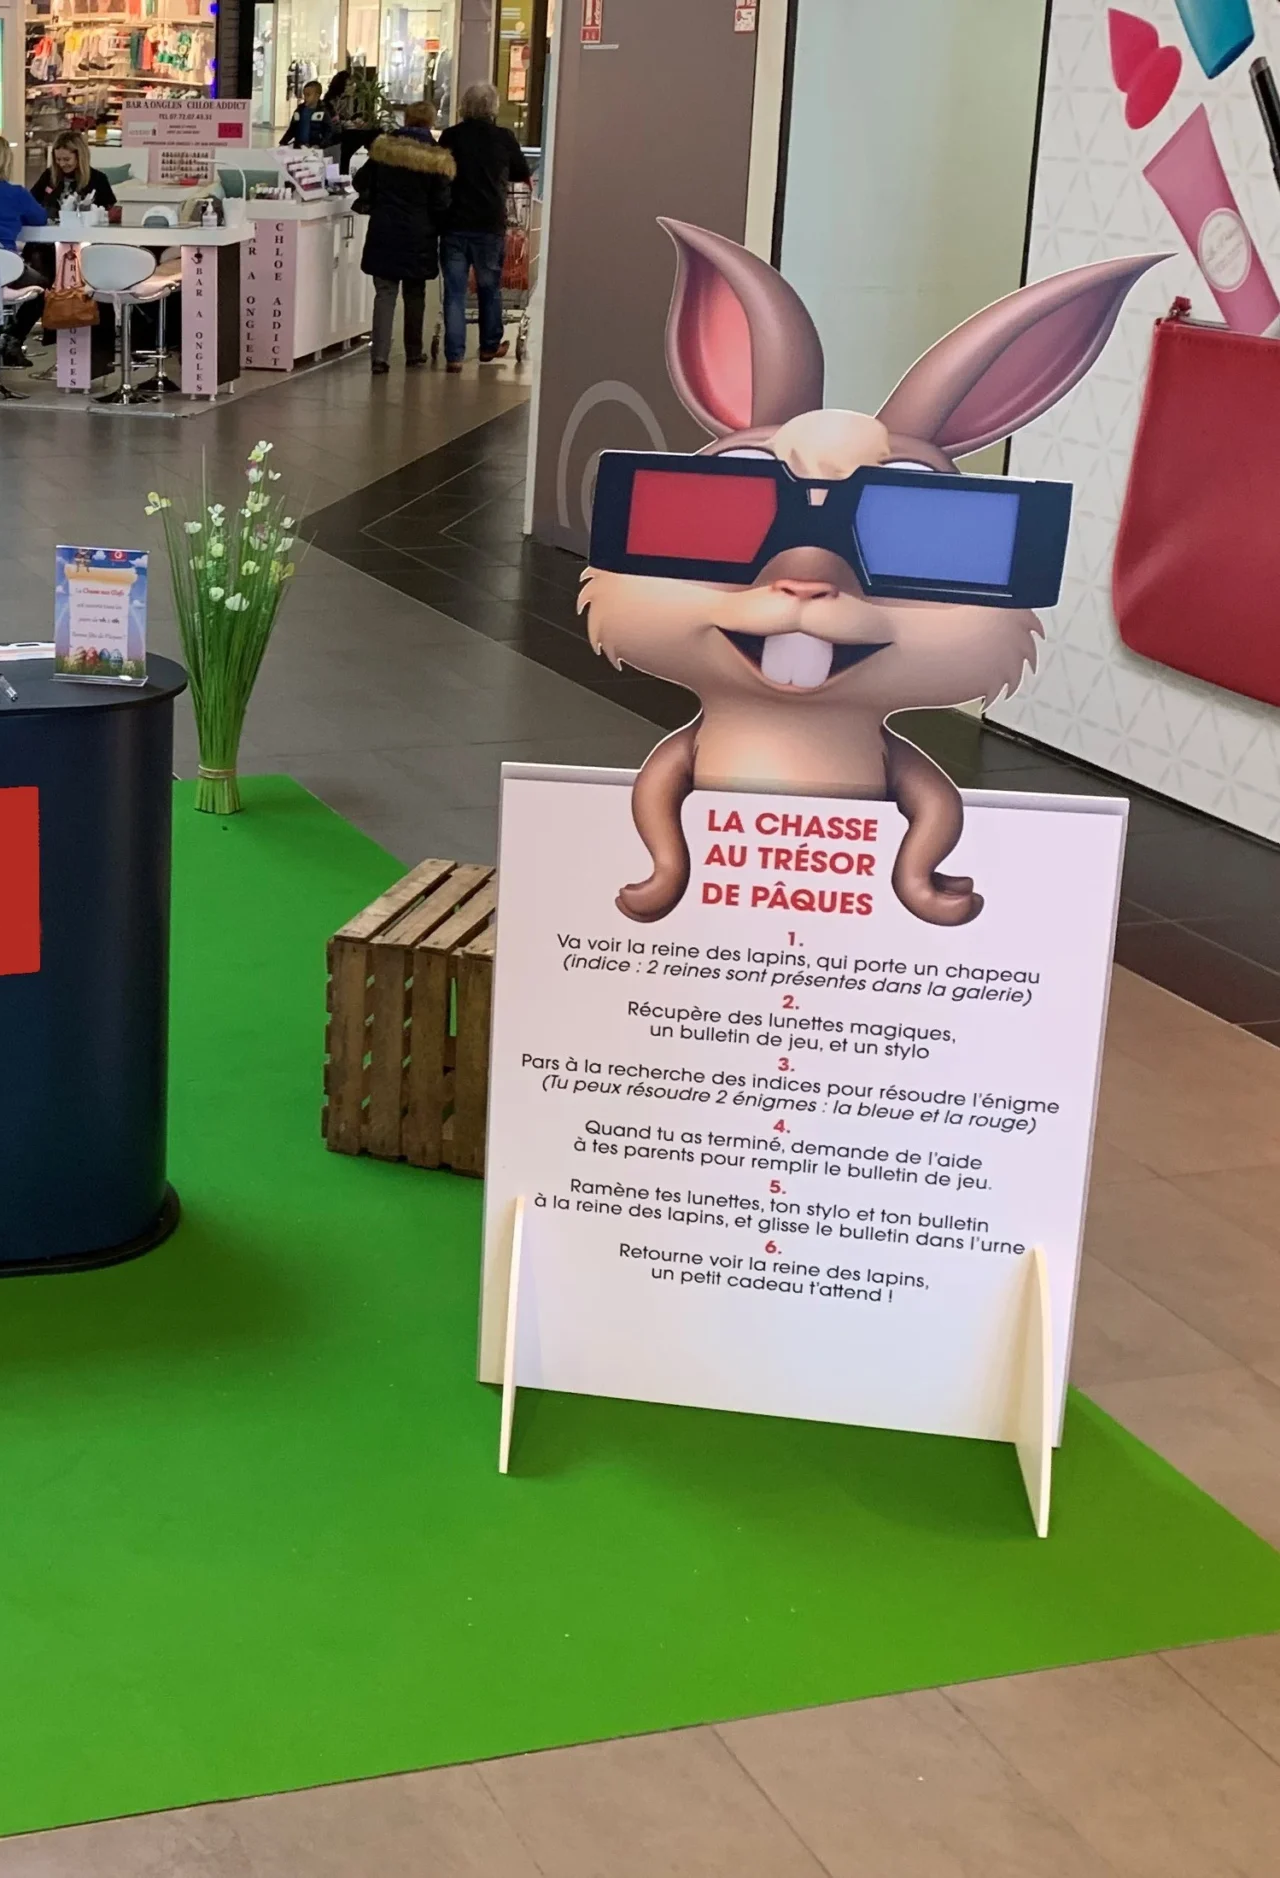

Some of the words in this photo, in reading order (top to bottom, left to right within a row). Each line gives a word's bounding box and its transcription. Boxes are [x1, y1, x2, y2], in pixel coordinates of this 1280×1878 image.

[125, 101, 142, 109] BAR
[143, 101, 150, 109] A
[150, 101, 182, 110] ONGLES
[186, 101, 214, 110] CHLOE
[216, 101, 247, 110] ADDICT
[274, 222, 285, 282] CHLOE
[195, 267, 203, 297] BAR
[247, 271, 256, 281] A
[195, 310, 203, 319] A
[245, 296, 256, 365] ONGLES
[271, 297, 282, 367] ADDICT
[195, 331, 203, 392] ONGLES
[707, 808, 746, 834] LA
[754, 812, 879, 843] CHASSE
[703, 843, 748, 868] AU
[757, 842, 877, 877] TRÉSOR
[701, 881, 741, 907] DE
[750, 880, 874, 917] PÂQUES
[787, 931, 804, 948] 1.
[556, 933, 581, 950] Va
[587, 937, 623, 953] voir
[627, 938, 646, 955] la
[651, 941, 701, 960] reine
[705, 945, 741, 962] des
[746, 947, 811, 969] lapins,
[816, 954, 848, 972] qui
[853, 958, 908, 975] porte
[913, 963, 939, 977] un
[945, 963, 1041, 985] chapeau
[562, 953, 631, 973] (indice
[645, 959, 659, 975] 2
[662, 960, 722, 980] reines
[724, 968, 768, 983] sont
[770, 970, 867, 991] présentes
[871, 976, 923, 996] dans
[926, 980, 947, 997] la
[951, 985, 1033, 1008] galerie)
[781, 994, 800, 1011] 2.
[627, 1000, 722, 1023] Récupère
[727, 1009, 763, 1027] des
[768, 1012, 844, 1034] lunettes
[849, 1022, 956, 1045] magiques,
[649, 1024, 674, 1038] un
[679, 1024, 750, 1045] bulletin
[755, 1031, 783, 1047] de
[787, 1033, 824, 1053] jeu,
[829, 1037, 849, 1053] et
[853, 1041, 879, 1056] un
[884, 1041, 930, 1061] stylo
[777, 1056, 796, 1073] 3.
[521, 1053, 560, 1071] Pars
[565, 1056, 579, 1072] à
[584, 1058, 602, 1075] la
[608, 1063, 706, 1084] recherche
[711, 1070, 747, 1088] des
[752, 1073, 821, 1094] indices
[826, 1083, 874, 1099] pour
[879, 1084, 967, 1107] résoudre
[972, 1092, 1060, 1115] l'énigme
[541, 1074, 569, 1093] (Tu
[572, 1079, 623, 1095] peux
[626, 1081, 711, 1103] résoudre
[714, 1089, 729, 1105] 2
[732, 1090, 818, 1113] énigmes
[832, 1099, 853, 1116] la
[856, 1101, 915, 1121] bleue
[919, 1108, 941, 1123] et
[943, 1109, 964, 1125] la
[968, 1114, 1037, 1135] rouge)
[772, 1118, 791, 1134] 4.
[584, 1119, 652, 1140] Quand
[656, 1126, 675, 1143] tu
[680, 1131, 703, 1145] as
[707, 1131, 786, 1154] terminé,
[790, 1139, 890, 1162] demande
[895, 1149, 922, 1165] de
[928, 1151, 983, 1171] l'aide
[573, 1136, 587, 1152] à
[591, 1138, 619, 1156] tes
[623, 1145, 695, 1163] parents
[700, 1152, 746, 1168] pour
[751, 1157, 819, 1176] remplir
[824, 1160, 842, 1177] le
[847, 1162, 918, 1184] bulletin
[924, 1170, 952, 1187] de
[955, 1172, 992, 1192] jeu.
[570, 1178, 650, 1200] Ramène
[654, 1186, 682, 1204] tes
[687, 1189, 765, 1214] lunettes,
[769, 1197, 801, 1215] ton
[806, 1202, 851, 1221] stylo
[856, 1207, 876, 1222] et
[880, 1208, 912, 1226] ton
[917, 1212, 989, 1233] bulletin
[769, 1179, 787, 1195] 5.
[533, 1192, 547, 1208] à
[552, 1194, 570, 1211] la
[576, 1199, 623, 1216] reine
[628, 1203, 662, 1220] des
[667, 1206, 729, 1229] lapins,
[733, 1214, 753, 1229] et
[757, 1216, 810, 1235] glisse
[815, 1220, 833, 1237] le
[839, 1223, 909, 1245] bulletin
[915, 1231, 965, 1250] dans
[970, 1235, 1026, 1256] l'urne
[764, 1239, 783, 1255] 6.
[619, 1242, 704, 1266] Retourne
[708, 1254, 744, 1270] voir
[748, 1256, 767, 1272] la
[772, 1260, 821, 1277] reine
[826, 1264, 861, 1282] des
[866, 1268, 929, 1291] lapins,
[651, 1267, 675, 1281] un
[680, 1270, 722, 1286] petit
[726, 1275, 804, 1294] cadeau
[808, 1280, 882, 1302] t'attend
